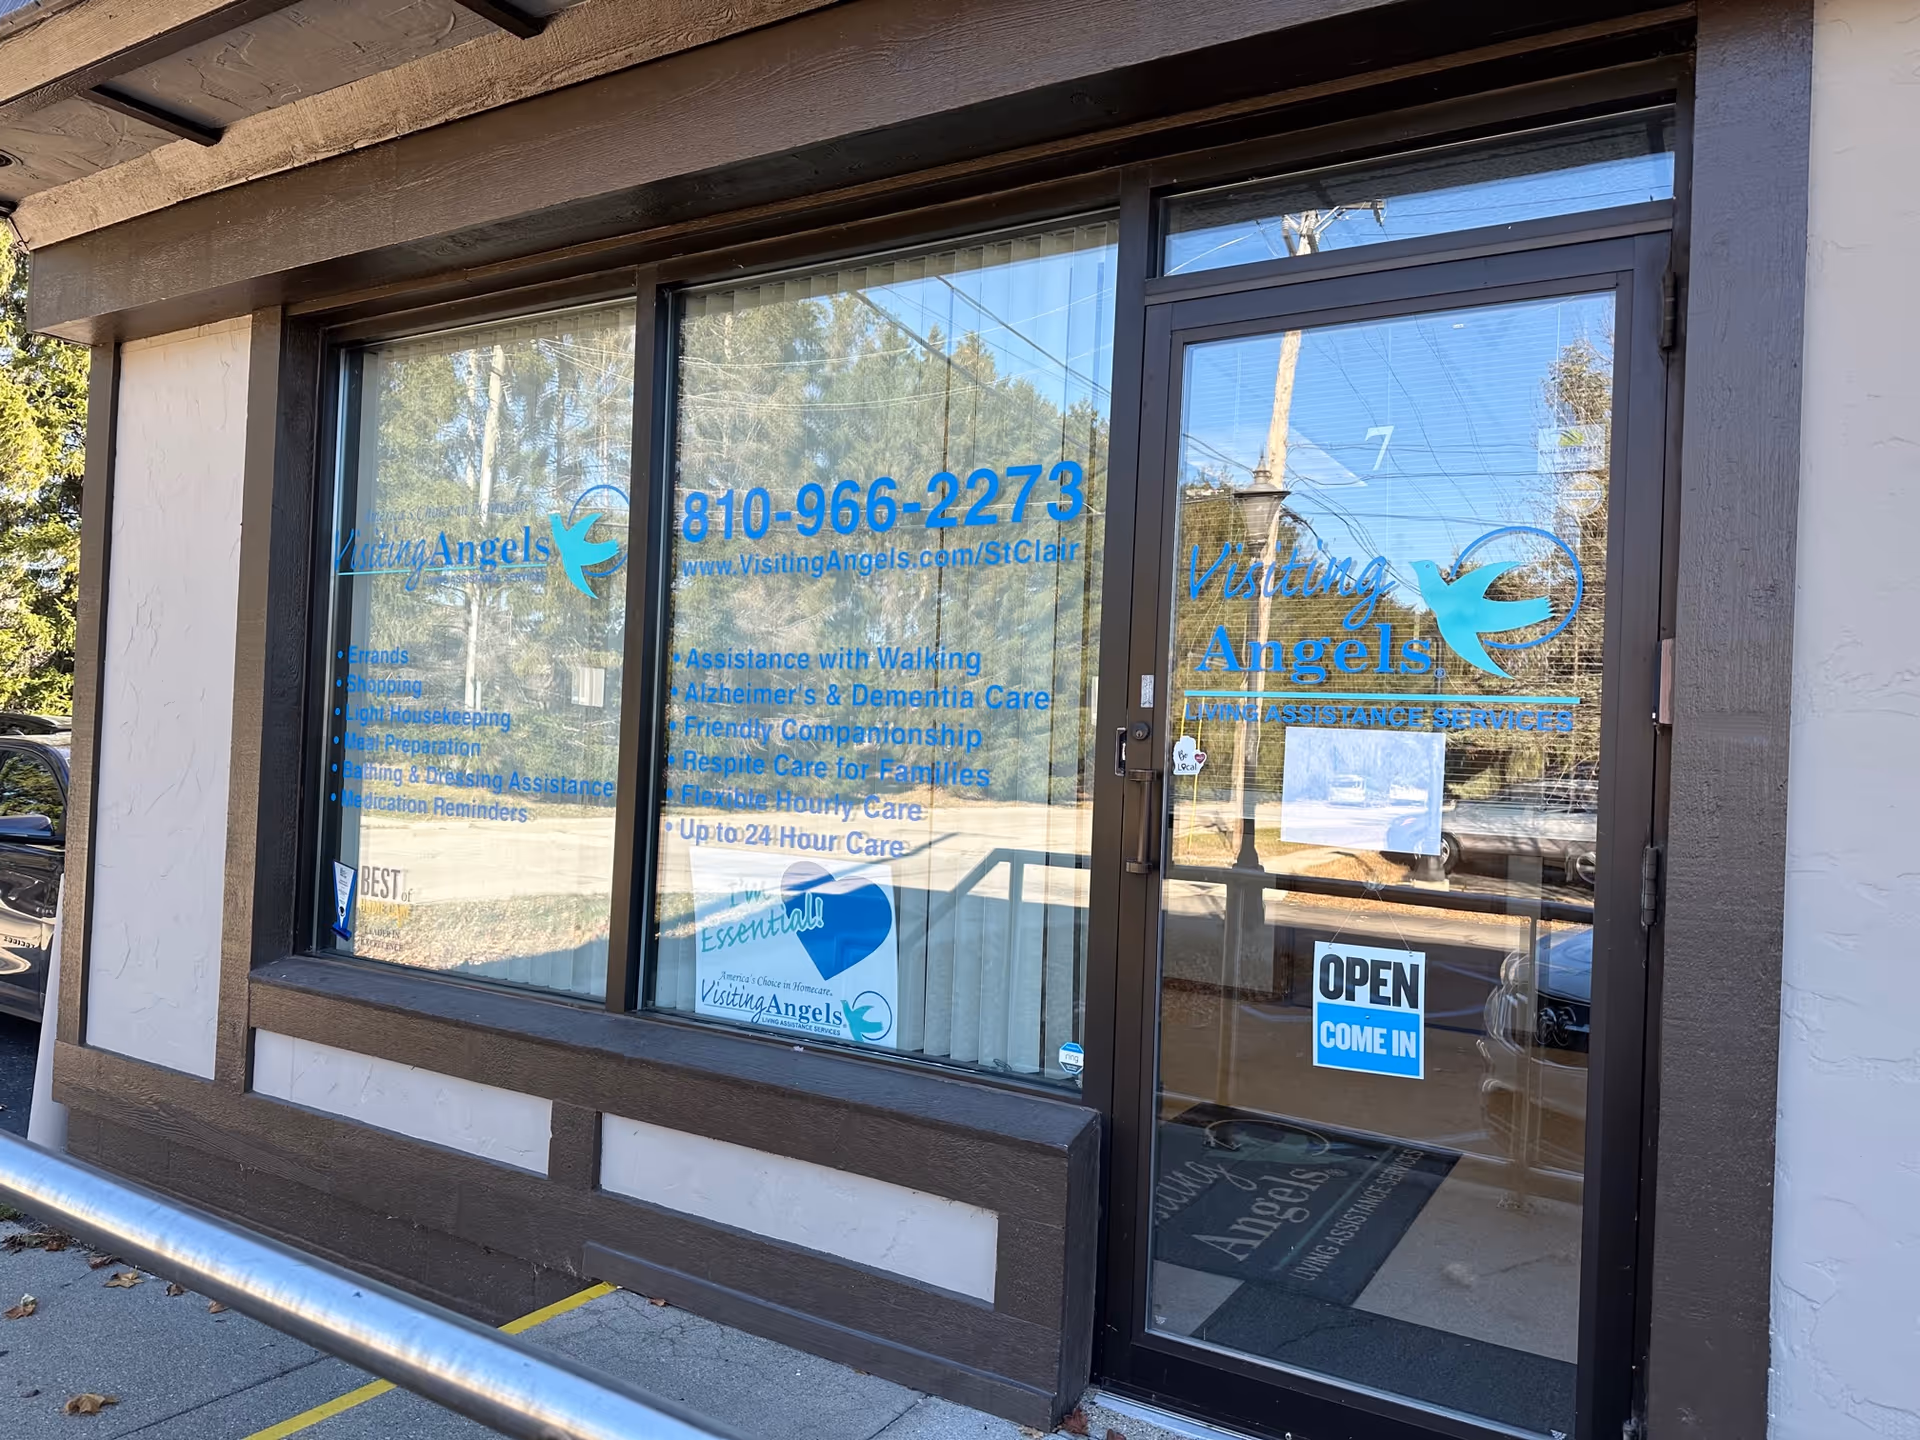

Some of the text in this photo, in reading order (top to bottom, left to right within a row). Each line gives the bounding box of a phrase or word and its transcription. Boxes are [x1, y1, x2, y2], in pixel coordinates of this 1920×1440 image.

[1364, 425, 1395, 472] 7
[682, 460, 1084, 543] 810-966-2273
[334, 525, 550, 591] Visiting Angels
[682, 536, 1081, 578] www.VisitingAngels.com/StClair
[1189, 537, 1399, 630] Visiting
[348, 645, 409, 664] Errands
[685, 646, 981, 676] Assistance with Walking
[1195, 623, 1431, 685] Angels
[347, 673, 422, 699] Shopping
[684, 682, 1050, 710] Alzheimer's & Dementia Care
[345, 704, 511, 732] Light Housekeeping
[684, 715, 983, 753] Friendly Companionship
[1185, 703, 1574, 732] LIVING ASSISTANCE SERVICES
[344, 731, 481, 758] Meal Preparation
[343, 760, 615, 798] Bathing & Dressing Assistance
[683, 750, 990, 787] Respite Care for Families
[341, 789, 528, 823] Medication Reminders
[681, 785, 923, 822] Flexible Hourly Care
[679, 818, 905, 857] Up to 24 Hour Care
[361, 865, 400, 899] BEST
[401, 888, 413, 902] of
[701, 891, 824, 953] Essential!
[718, 971, 755, 985] America's
[757, 975, 782, 989] Choice
[783, 979, 791, 990] in
[1318, 953, 1420, 1010] OPEN
[701, 978, 843, 1025] Visiting Angels
[762, 1016, 841, 1036] LIVING ASSISTANCE SERVICES
[1319, 1020, 1417, 1058] COME IN
[1065, 1053, 1079, 1063] ring
[1191, 1167, 1330, 1263] Angels
[1289, 1147, 1425, 1281] LIVING ASSISTANCE SERVICES
